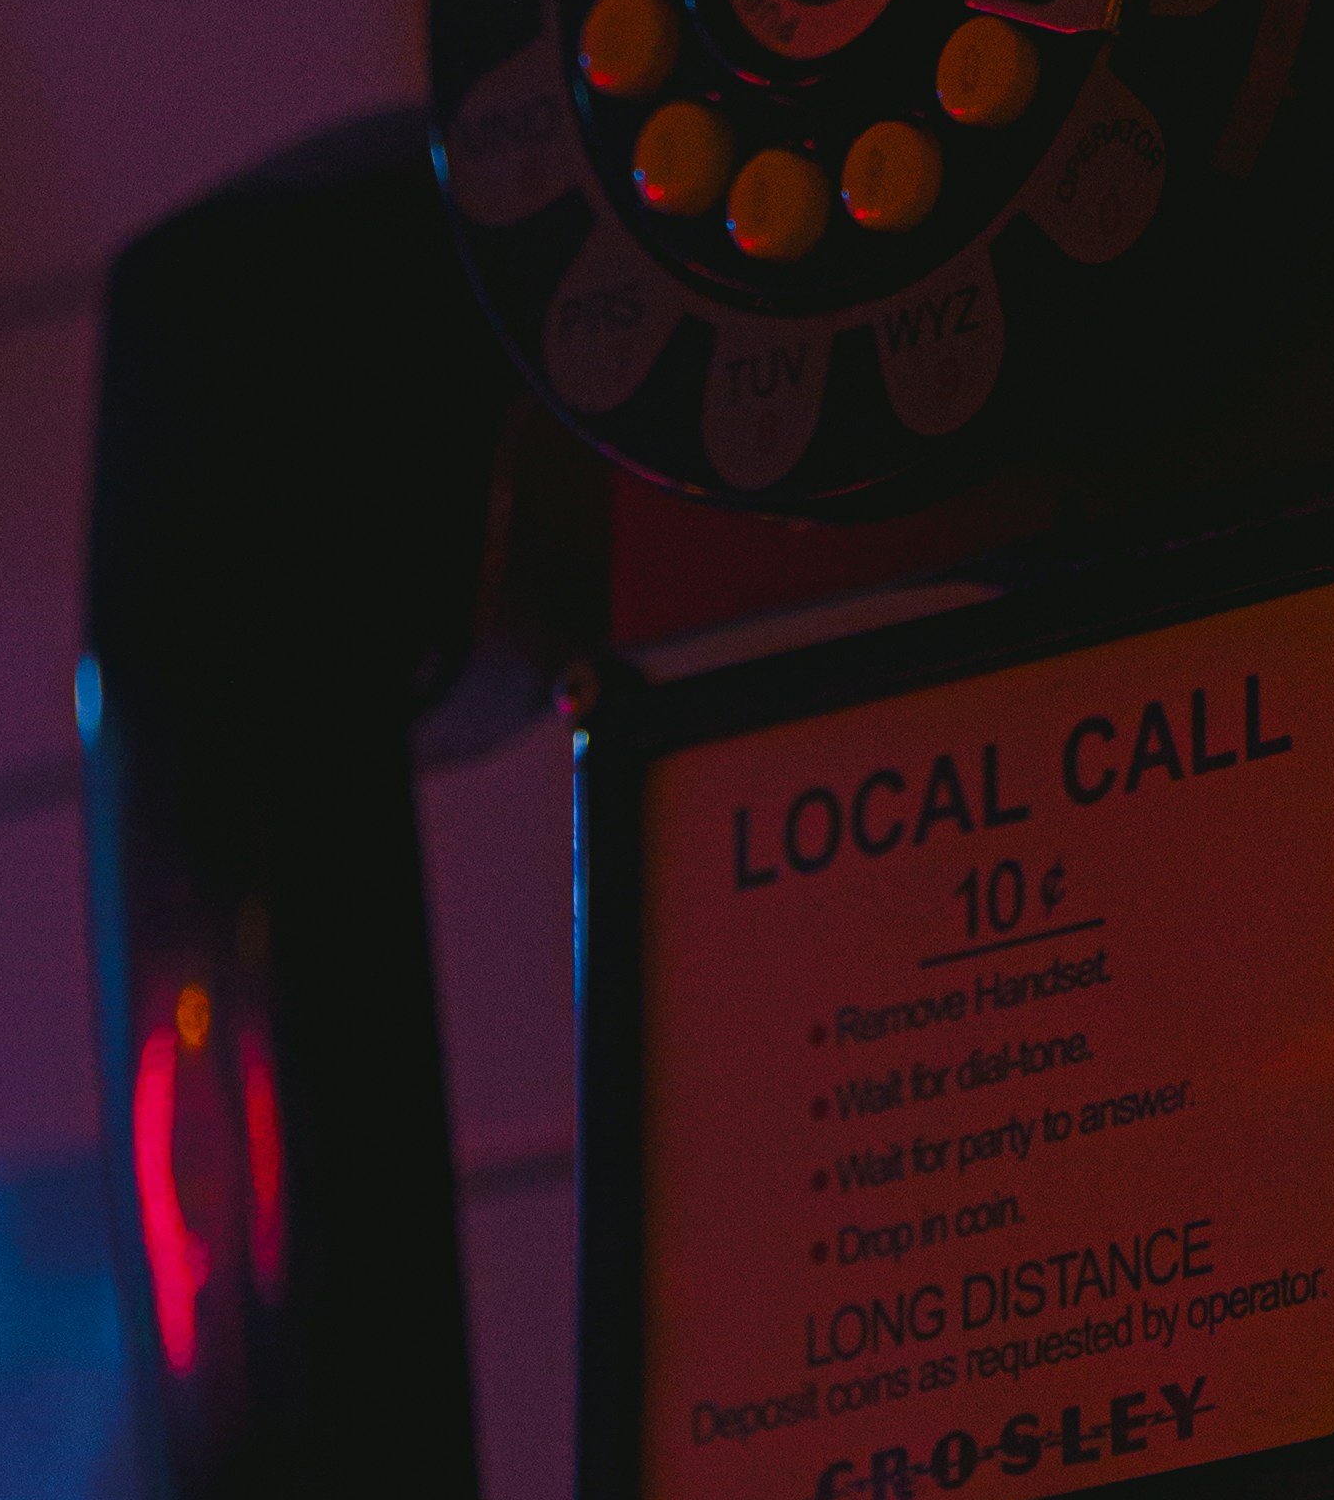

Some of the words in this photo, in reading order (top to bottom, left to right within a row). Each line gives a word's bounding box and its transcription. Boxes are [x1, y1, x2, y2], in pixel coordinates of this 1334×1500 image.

[1056, 117, 1162, 205] OPERATOR
[882, 285, 980, 355] WYZ
[724, 342, 808, 405] TUV
[733, 742, 1031, 892] LOCAL
[1062, 673, 1294, 807] CALL
[835, 990, 967, 1047] Remove
[834, 1068, 905, 1121] Wait
[910, 1061, 953, 1101] for
[956, 1032, 1096, 1091] dial-tone.
[835, 1141, 906, 1194] Wait
[912, 1135, 953, 1176] for
[957, 1112, 1037, 1177] party
[1042, 1106, 1073, 1144] to
[1078, 1079, 1197, 1135] answer.
[836, 1224, 915, 1267] Drop
[920, 1208, 950, 1248] in
[954, 1190, 1028, 1238] coin.
[806, 1284, 946, 1369] LONG
[960, 1217, 1215, 1331] DISTANCE
[690, 1380, 820, 1447] Deposit
[827, 1364, 912, 1417] coins
[917, 1354, 959, 1392] as
[966, 1303, 1134, 1384] requested
[1141, 1298, 1179, 1347] by
[1186, 1267, 1330, 1334] operator.
